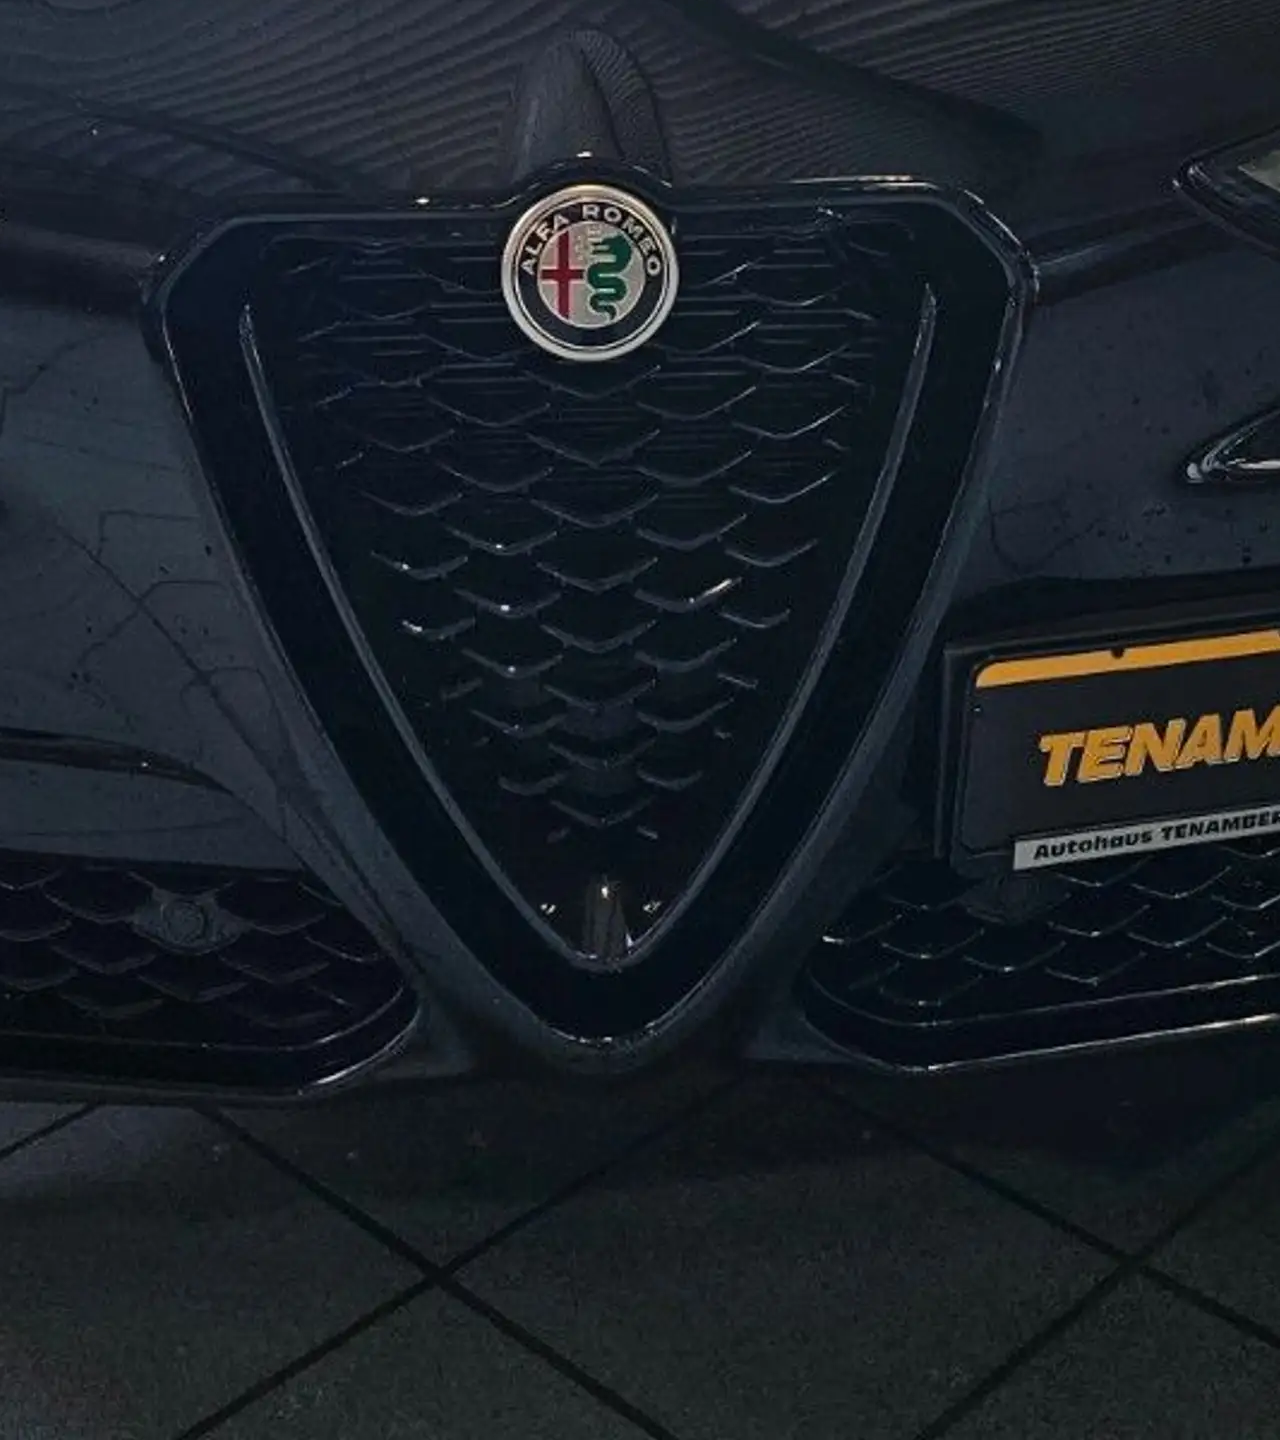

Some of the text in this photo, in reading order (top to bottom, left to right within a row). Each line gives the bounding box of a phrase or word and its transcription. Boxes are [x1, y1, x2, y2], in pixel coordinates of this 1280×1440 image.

[520, 203, 662, 277] ALFA ROMEO
[1032, 830, 1154, 861] Autohaus
